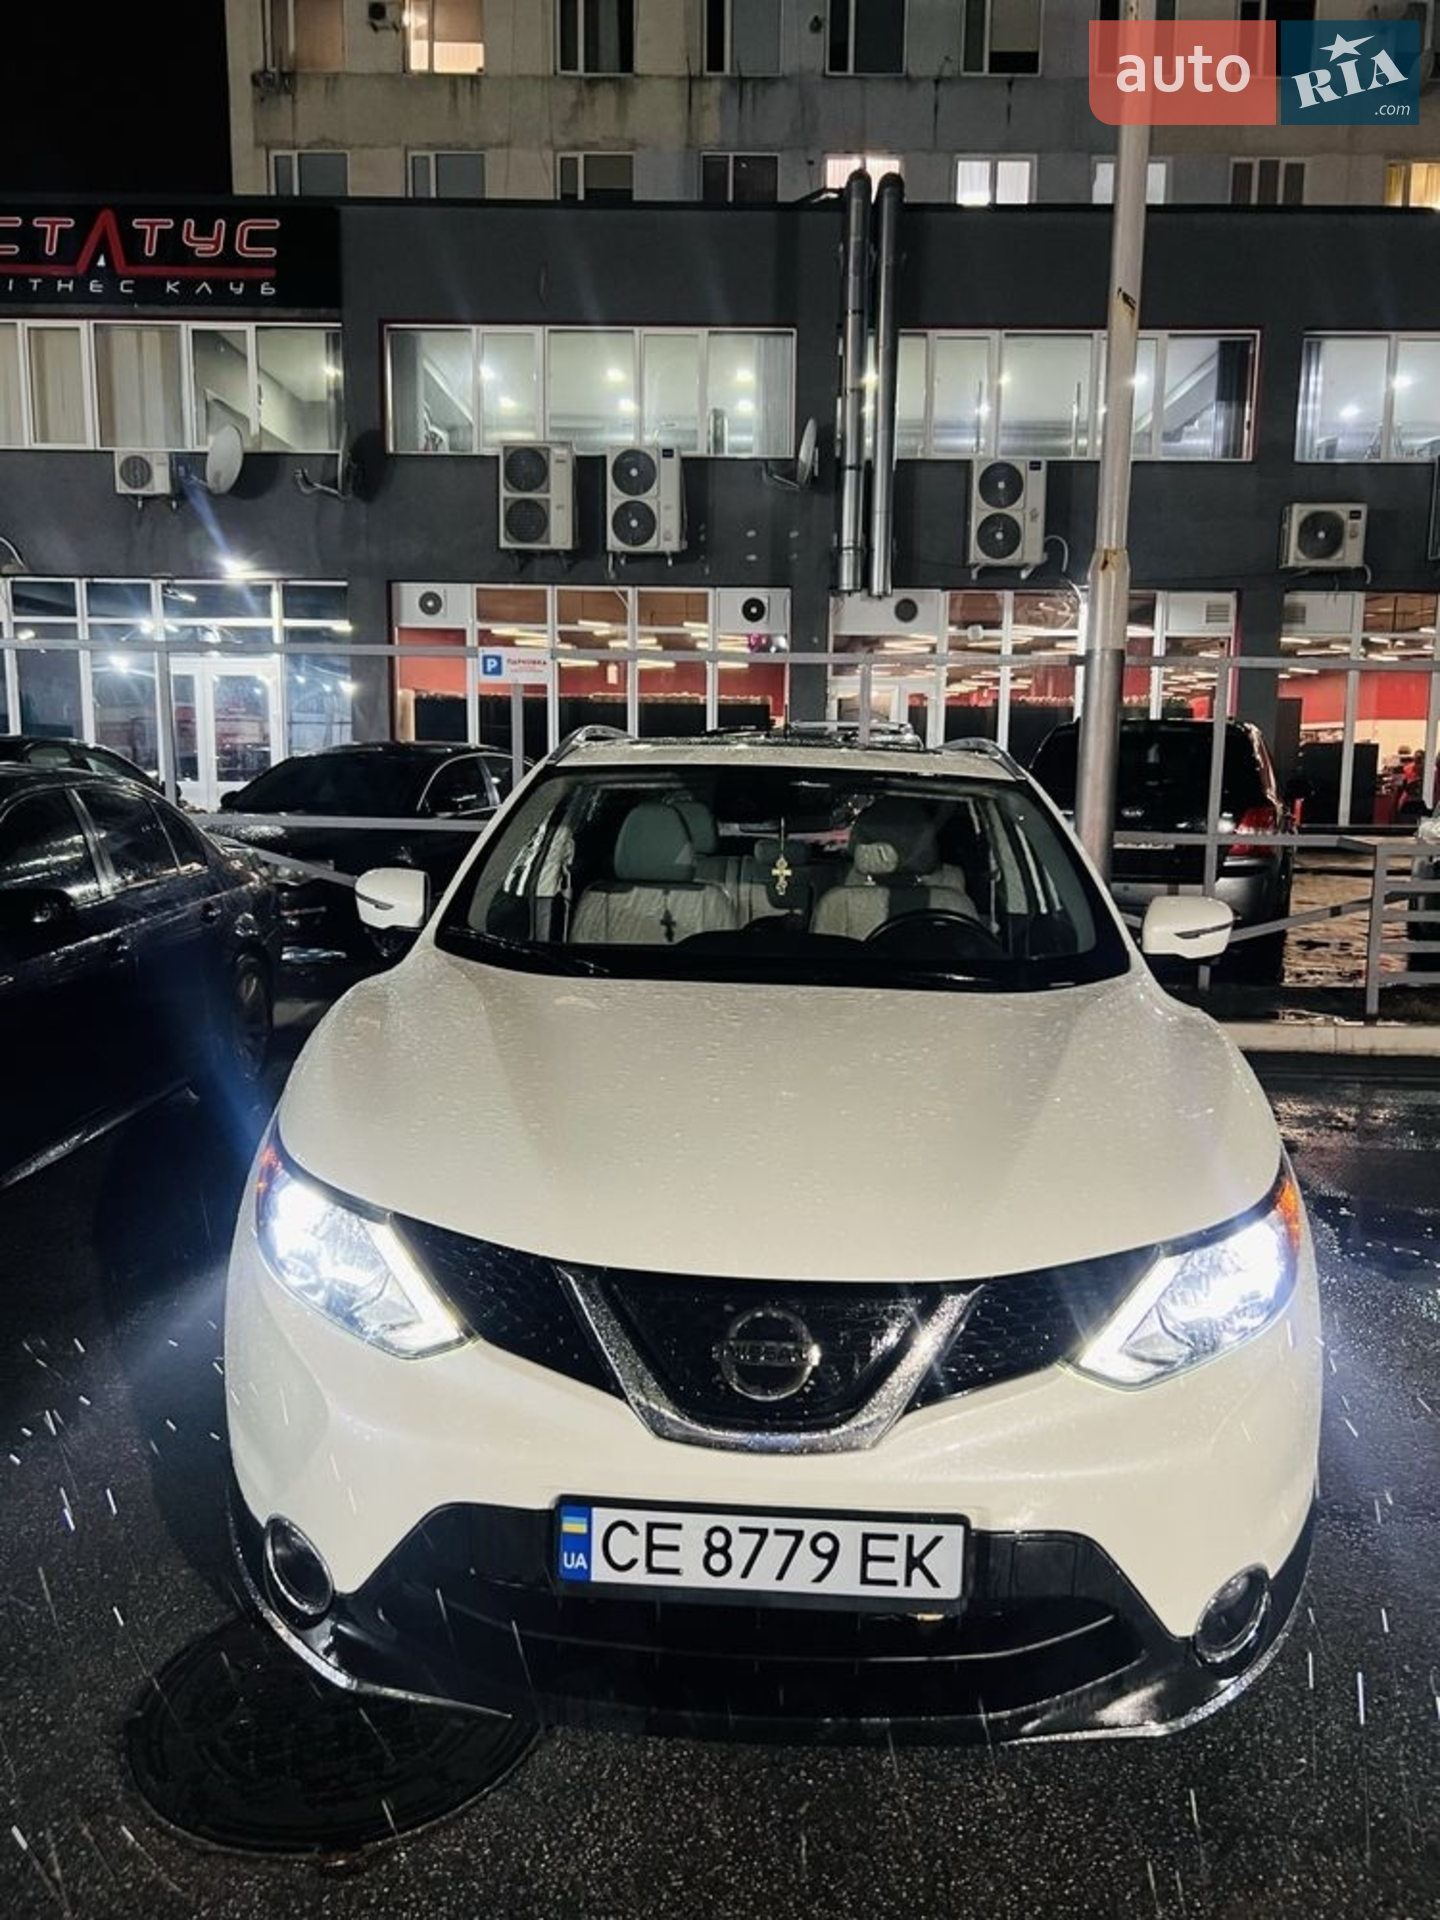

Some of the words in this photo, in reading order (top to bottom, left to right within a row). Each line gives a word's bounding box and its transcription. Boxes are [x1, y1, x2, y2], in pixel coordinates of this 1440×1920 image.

[166, 280, 276, 295] КЛУБ
[563, 1550, 588, 1569] UA
[601, 1519, 683, 1576] CE
[702, 1525, 841, 1583] 8779
[859, 1532, 944, 1589] EK
